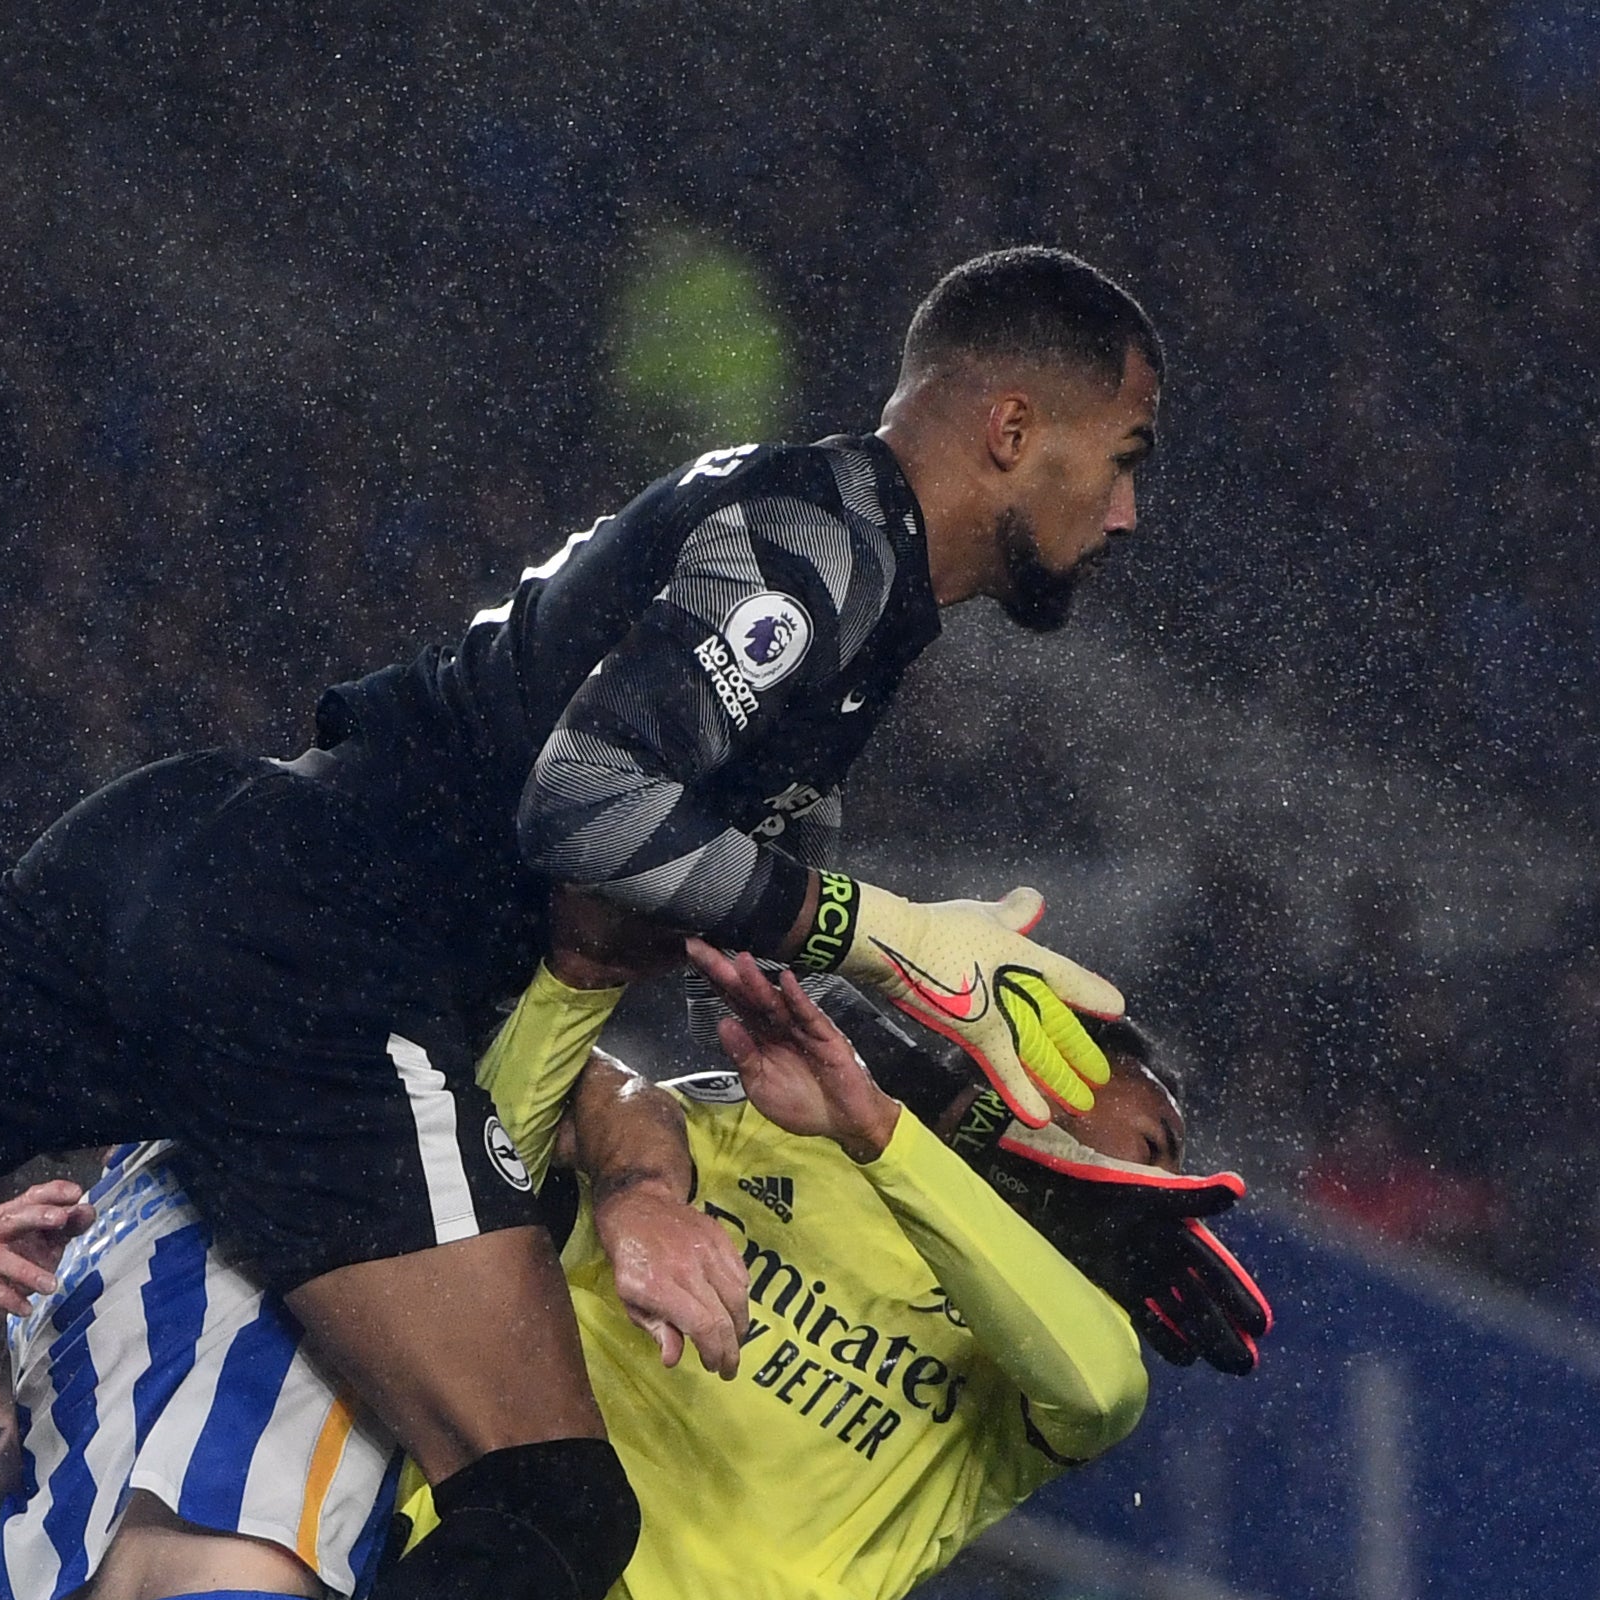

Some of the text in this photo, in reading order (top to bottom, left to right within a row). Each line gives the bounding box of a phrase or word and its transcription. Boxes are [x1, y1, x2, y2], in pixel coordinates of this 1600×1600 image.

[693, 634, 760, 714] No room
[711, 671, 749, 732] racism
[738, 1177, 794, 1224] adidas
[752, 1339, 902, 1461] BETTER
